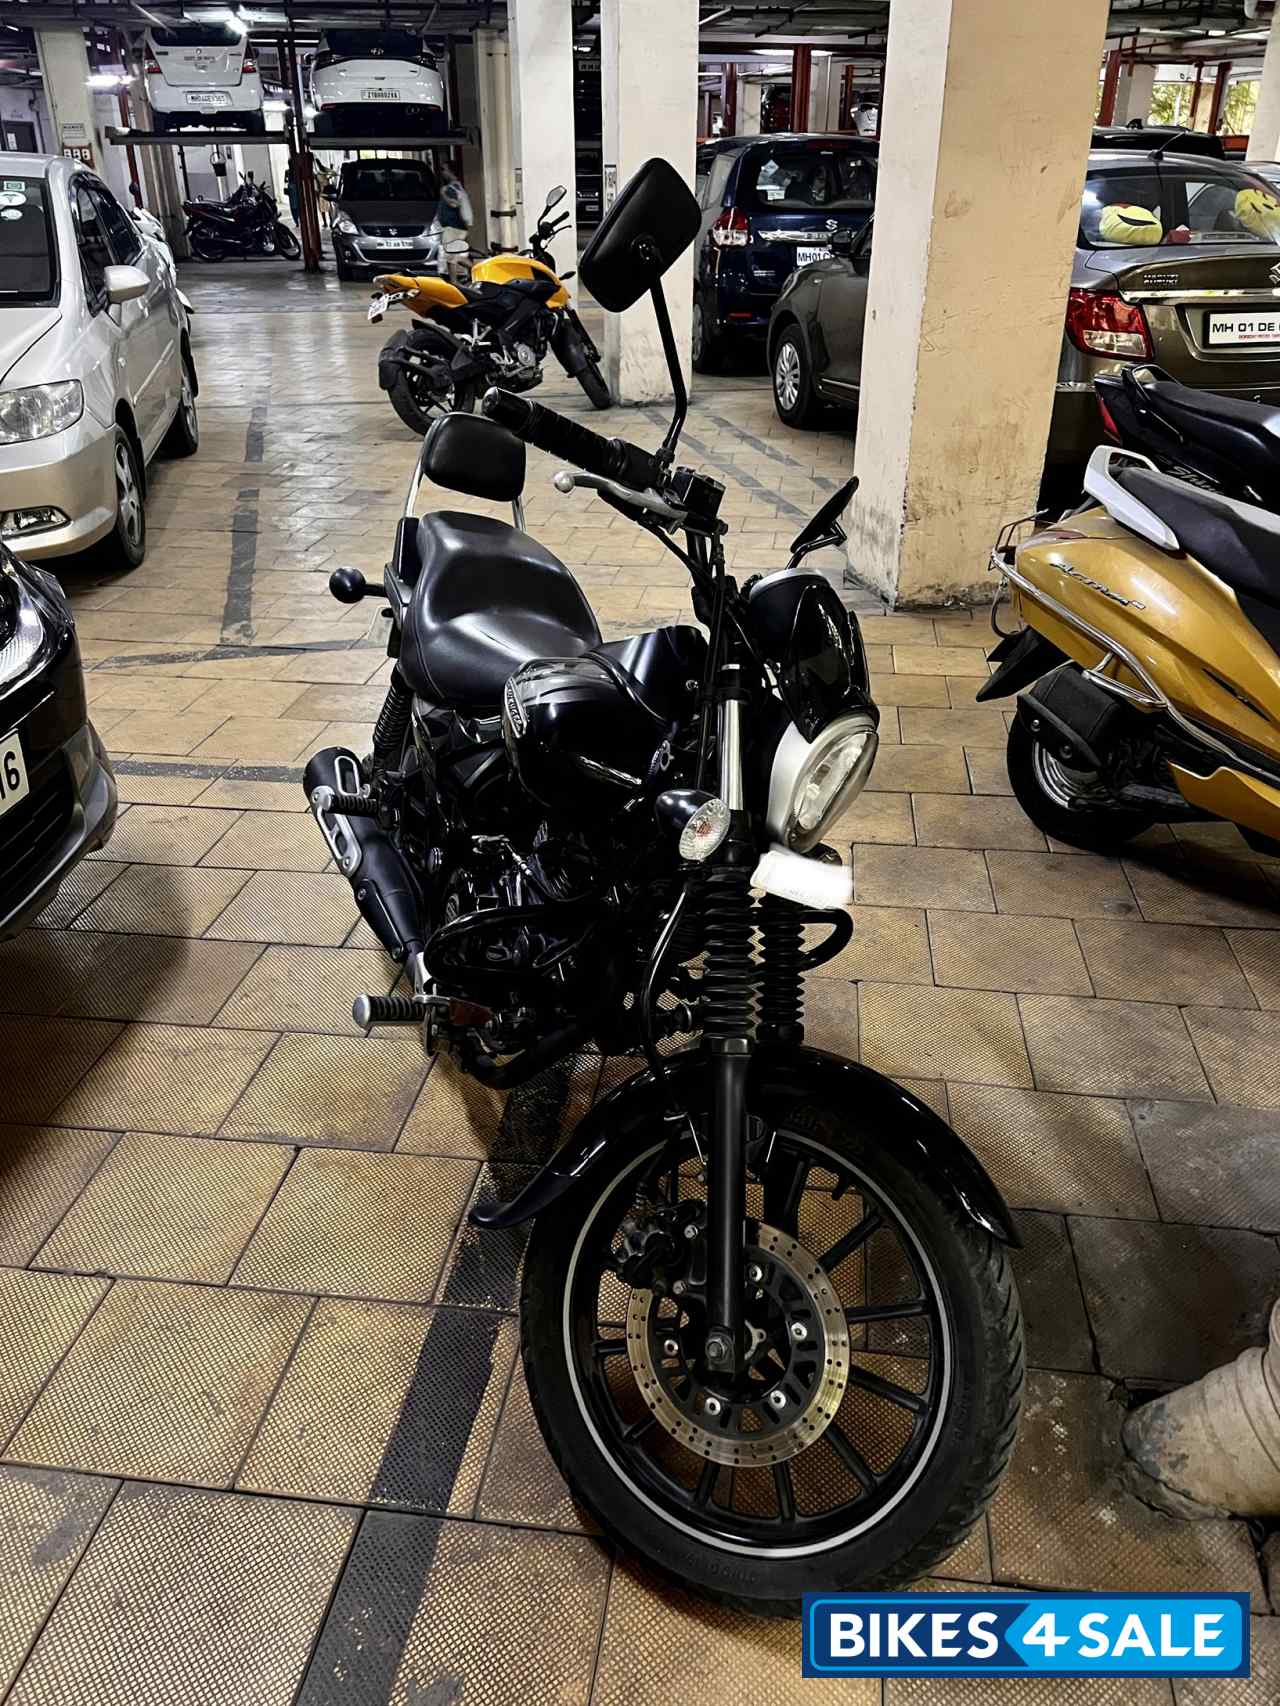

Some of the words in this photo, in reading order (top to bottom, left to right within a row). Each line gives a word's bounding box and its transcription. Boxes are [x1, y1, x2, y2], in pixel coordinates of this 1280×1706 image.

[1212, 323, 1234, 333] MH
[1238, 322, 1254, 332] 01
[1258, 322, 1275, 332] DE
